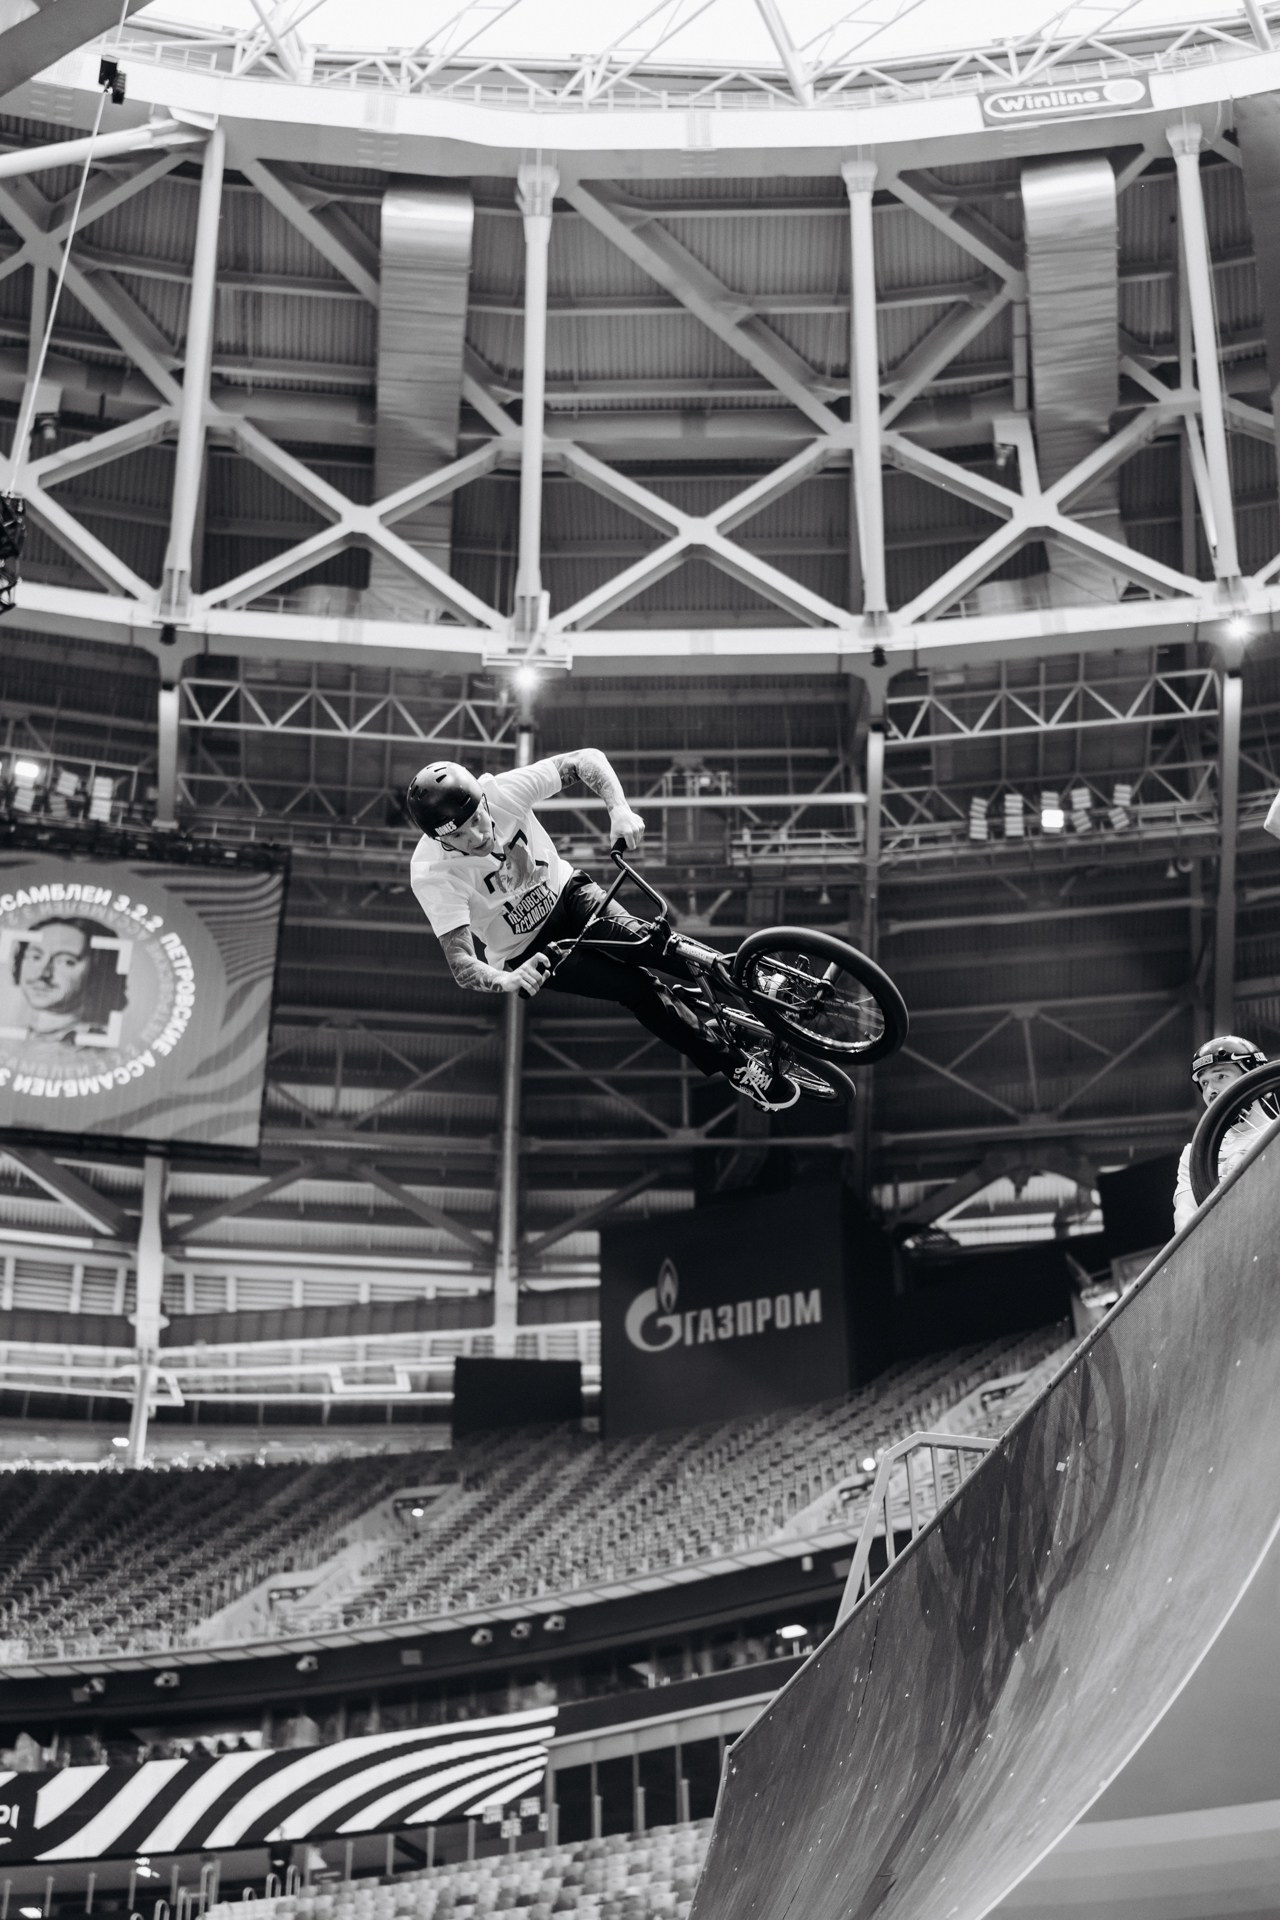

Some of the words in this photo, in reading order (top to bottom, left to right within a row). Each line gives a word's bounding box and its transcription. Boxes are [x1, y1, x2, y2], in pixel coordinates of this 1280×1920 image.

[998, 90, 1100, 112] Winline
[0, 883, 112, 916] САМБЛЕИ
[152, 932, 196, 1056] ПЕТРОВСКИЕ
[684, 1289, 822, 1347] ГАЗПРОМ
